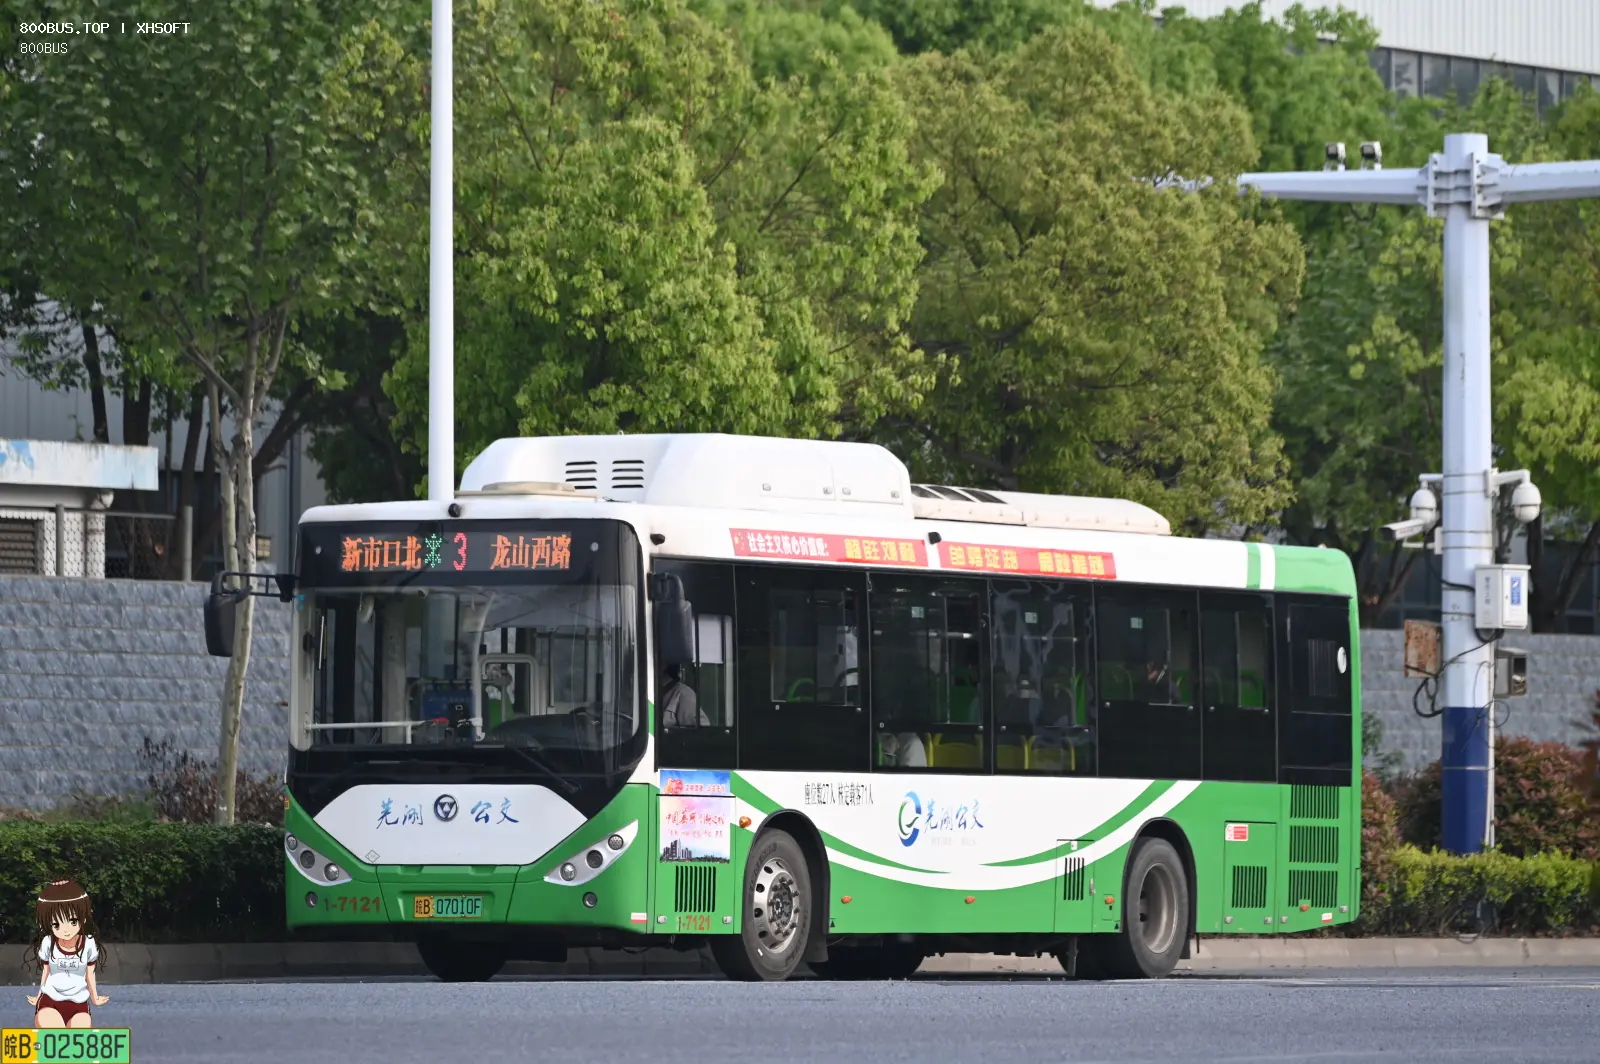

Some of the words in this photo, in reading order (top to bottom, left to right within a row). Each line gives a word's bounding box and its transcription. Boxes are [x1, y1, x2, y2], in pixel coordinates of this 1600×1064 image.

[342, 536, 422, 571] 新市口北
[453, 532, 467, 571] 3
[490, 534, 571, 570] 龙山西路
[376, 797, 424, 829] 芜湖
[471, 797, 519, 825] 公交
